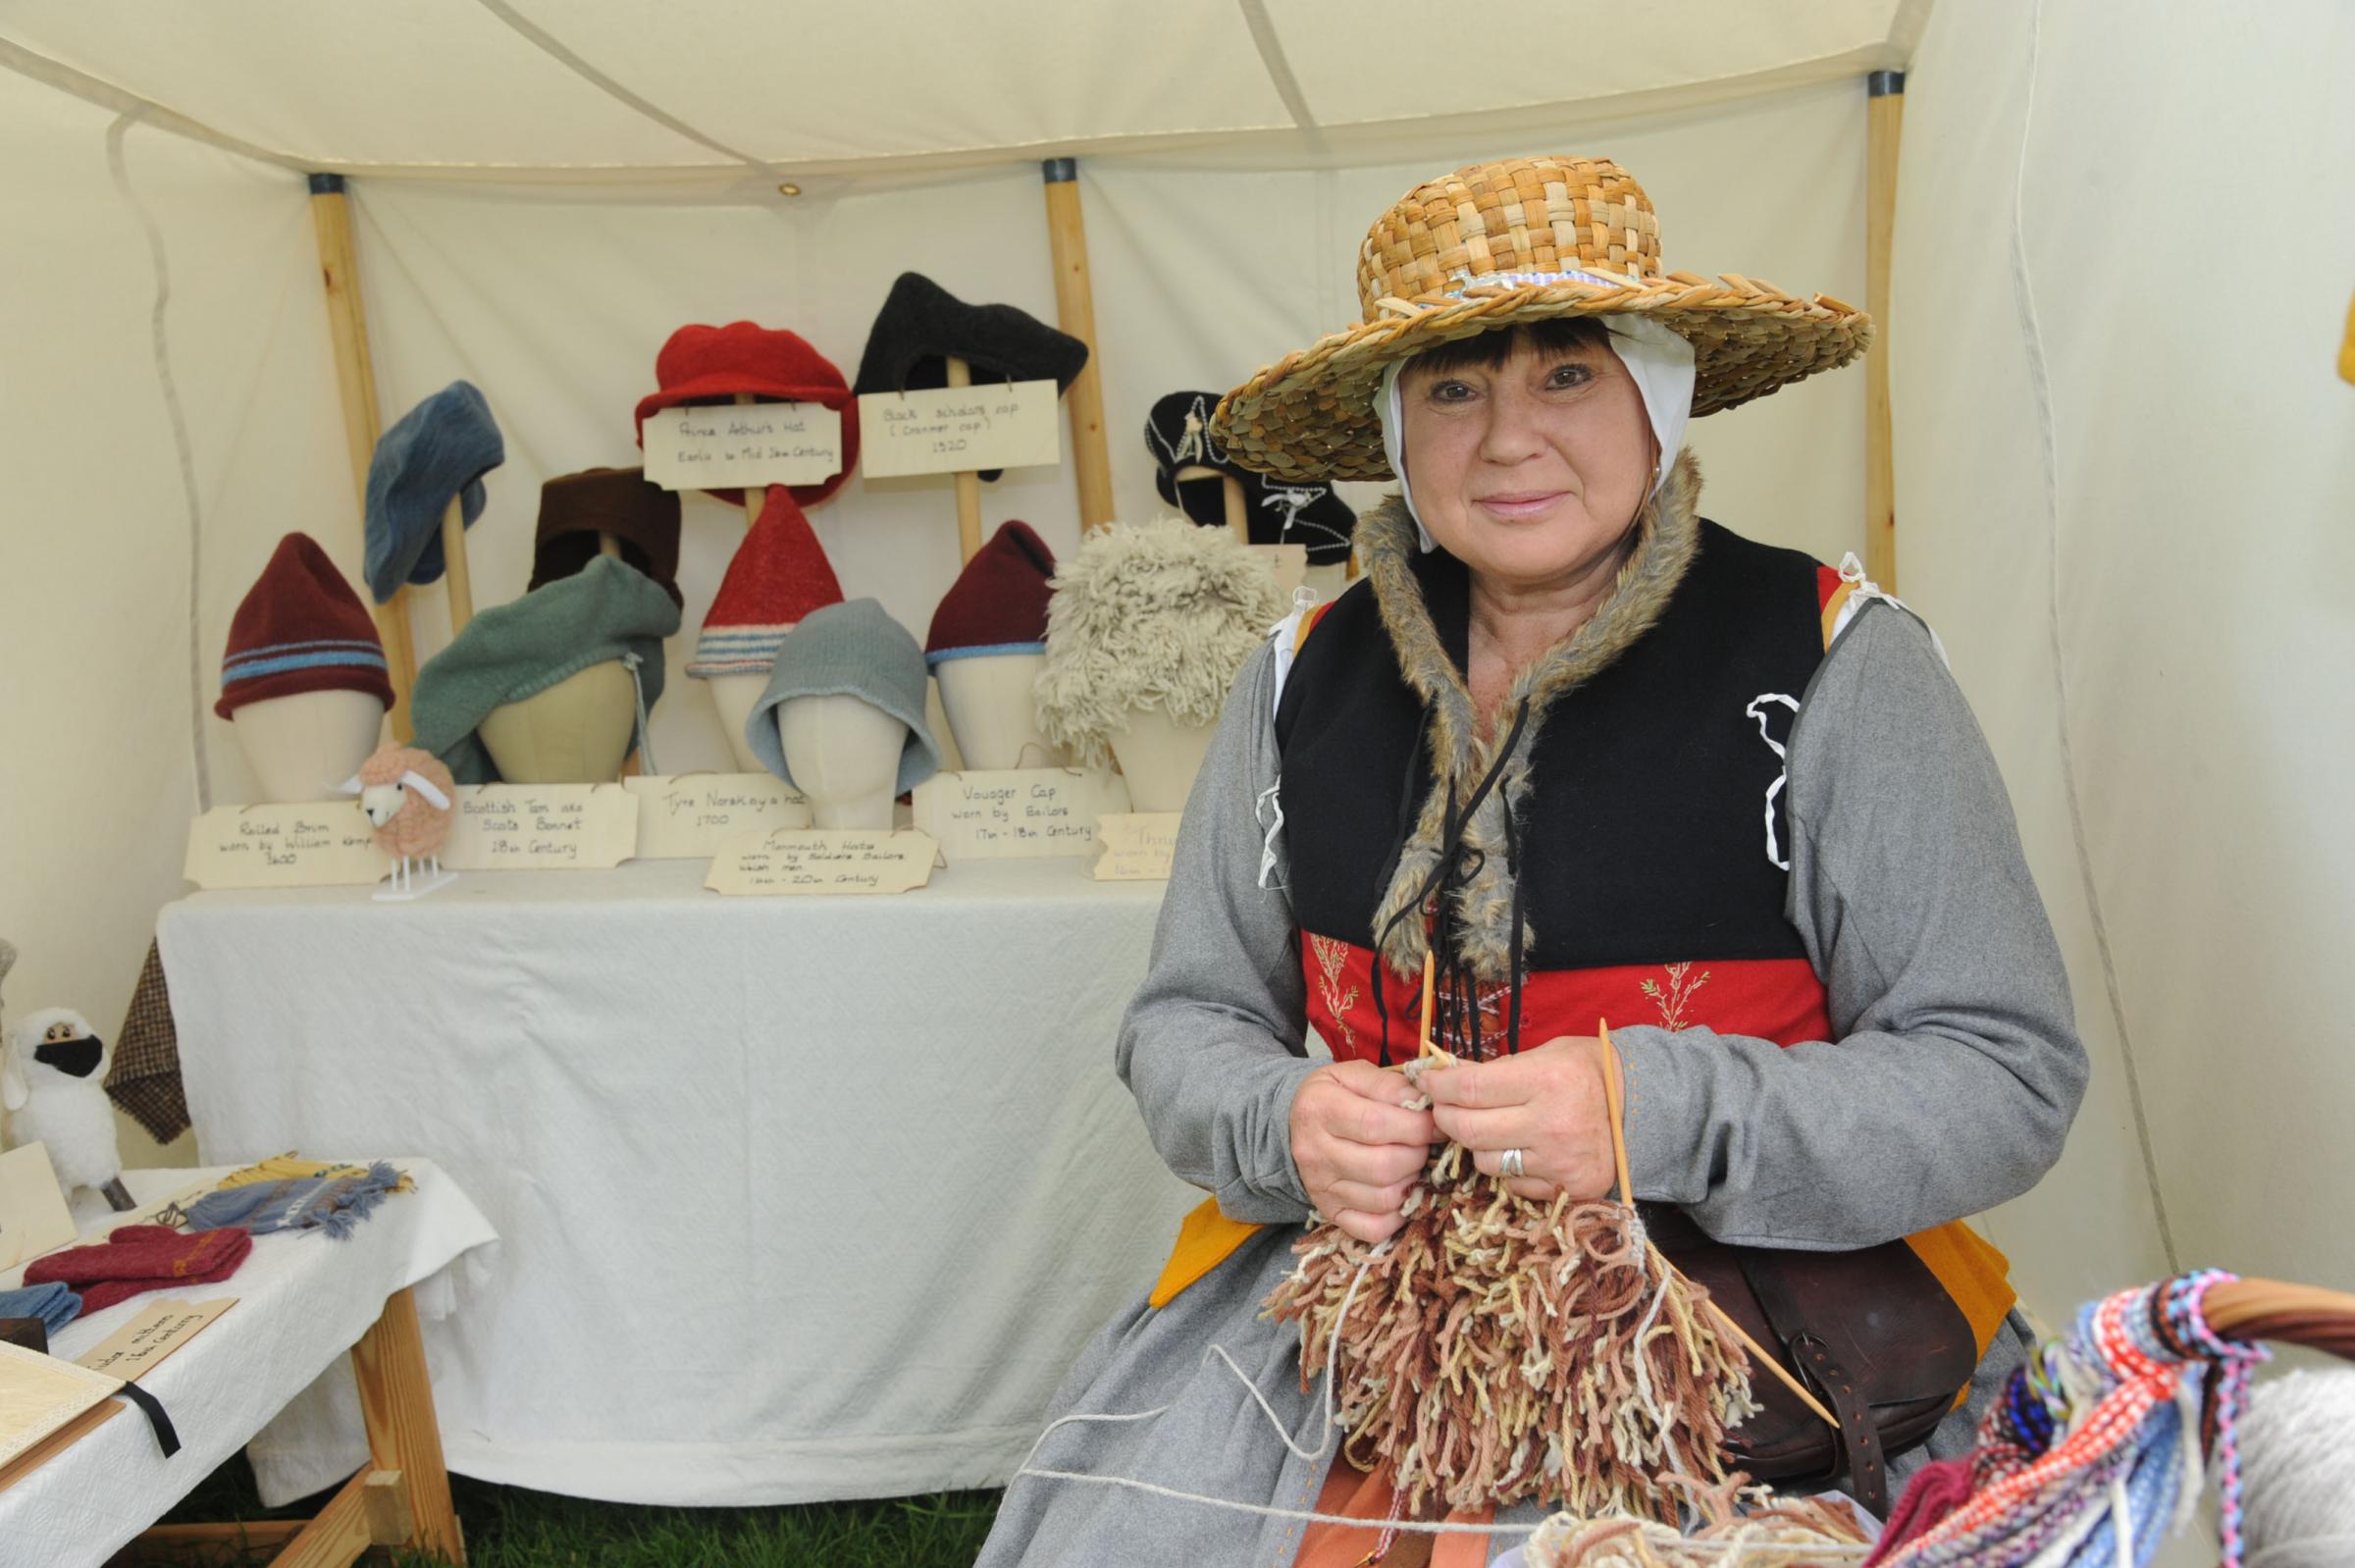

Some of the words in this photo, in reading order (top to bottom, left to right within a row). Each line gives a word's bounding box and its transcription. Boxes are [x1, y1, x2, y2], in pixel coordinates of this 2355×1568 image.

[995, 403, 1019, 418] cap
[1030, 784, 1057, 801] Cap
[463, 799, 516, 814] Scottish
[952, 810, 981, 819] worn
[992, 806, 1009, 822] by
[294, 820, 329, 834] Brim
[483, 818, 518, 831] Scots
[536, 816, 583, 831] Bonnet
[696, 814, 729, 826] 1700
[1046, 823, 1092, 841] Century
[219, 842, 249, 852] worn
[259, 840, 273, 851] by
[528, 839, 577, 860] Century
[787, 853, 798, 862] by
[834, 873, 879, 887] Century
[152, 1315, 204, 1343] Century
